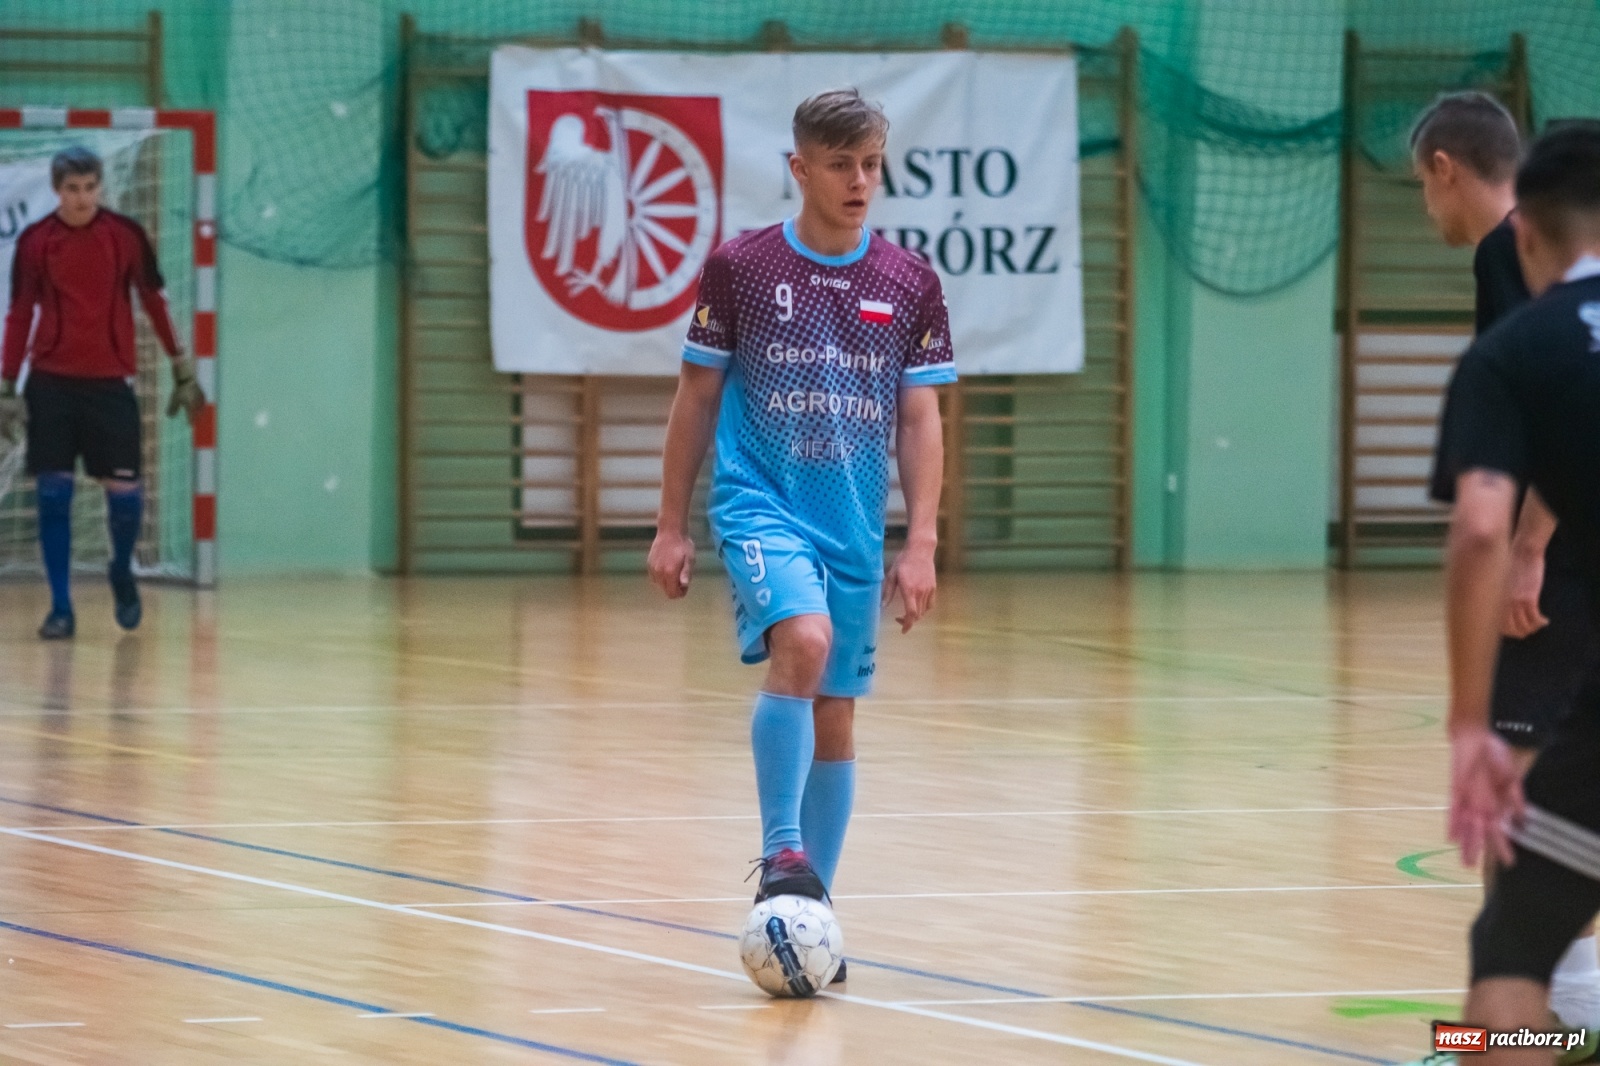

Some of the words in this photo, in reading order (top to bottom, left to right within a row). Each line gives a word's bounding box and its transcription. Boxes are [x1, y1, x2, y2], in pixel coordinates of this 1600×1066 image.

[775, 283, 793, 322] 9
[766, 343, 885, 373] Geo-Punkt
[767, 390, 882, 422] AGROTIM
[742, 538, 767, 584] 9
